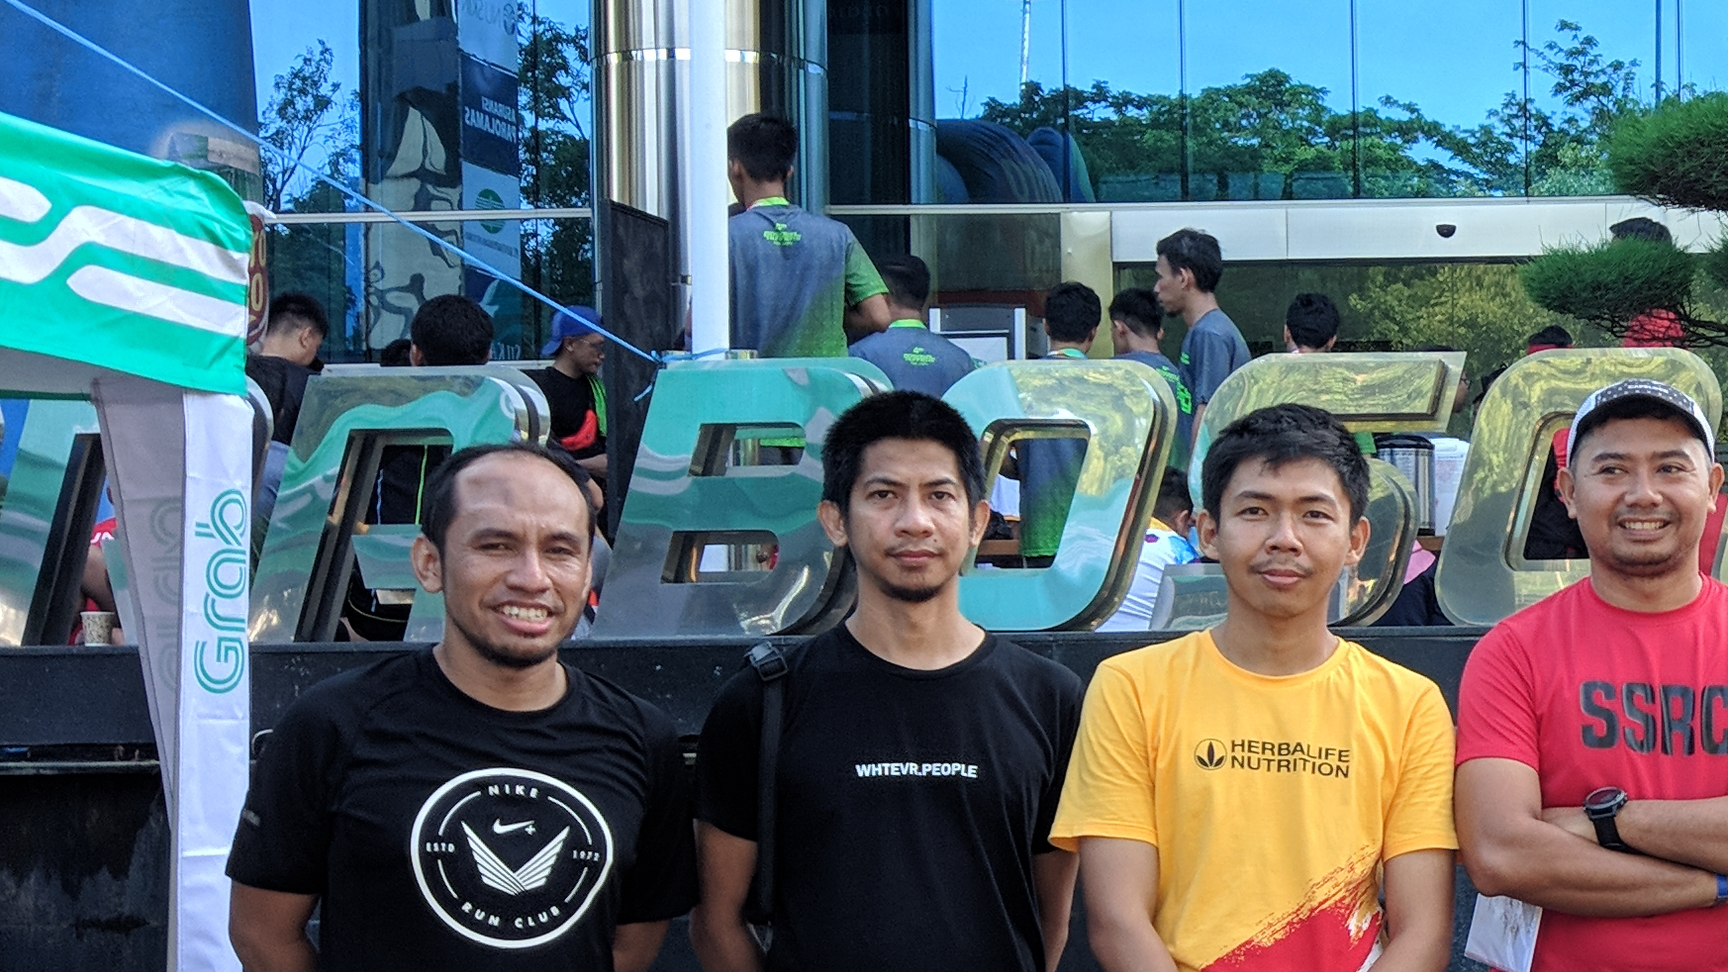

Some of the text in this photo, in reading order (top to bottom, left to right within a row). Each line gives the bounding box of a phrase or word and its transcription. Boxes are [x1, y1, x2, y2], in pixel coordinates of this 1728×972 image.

[193, 488, 249, 694] Grab
[1230, 738, 1351, 764] HERBALIFE
[855, 762, 979, 779] WHTEVR.PEOPLE
[1229, 755, 1351, 779] NUTRITION
[487, 784, 540, 799] NIKE
[425, 841, 456, 853] ESTD
[572, 849, 601, 862] 1972
[460, 900, 561, 929] RUN CLUB
